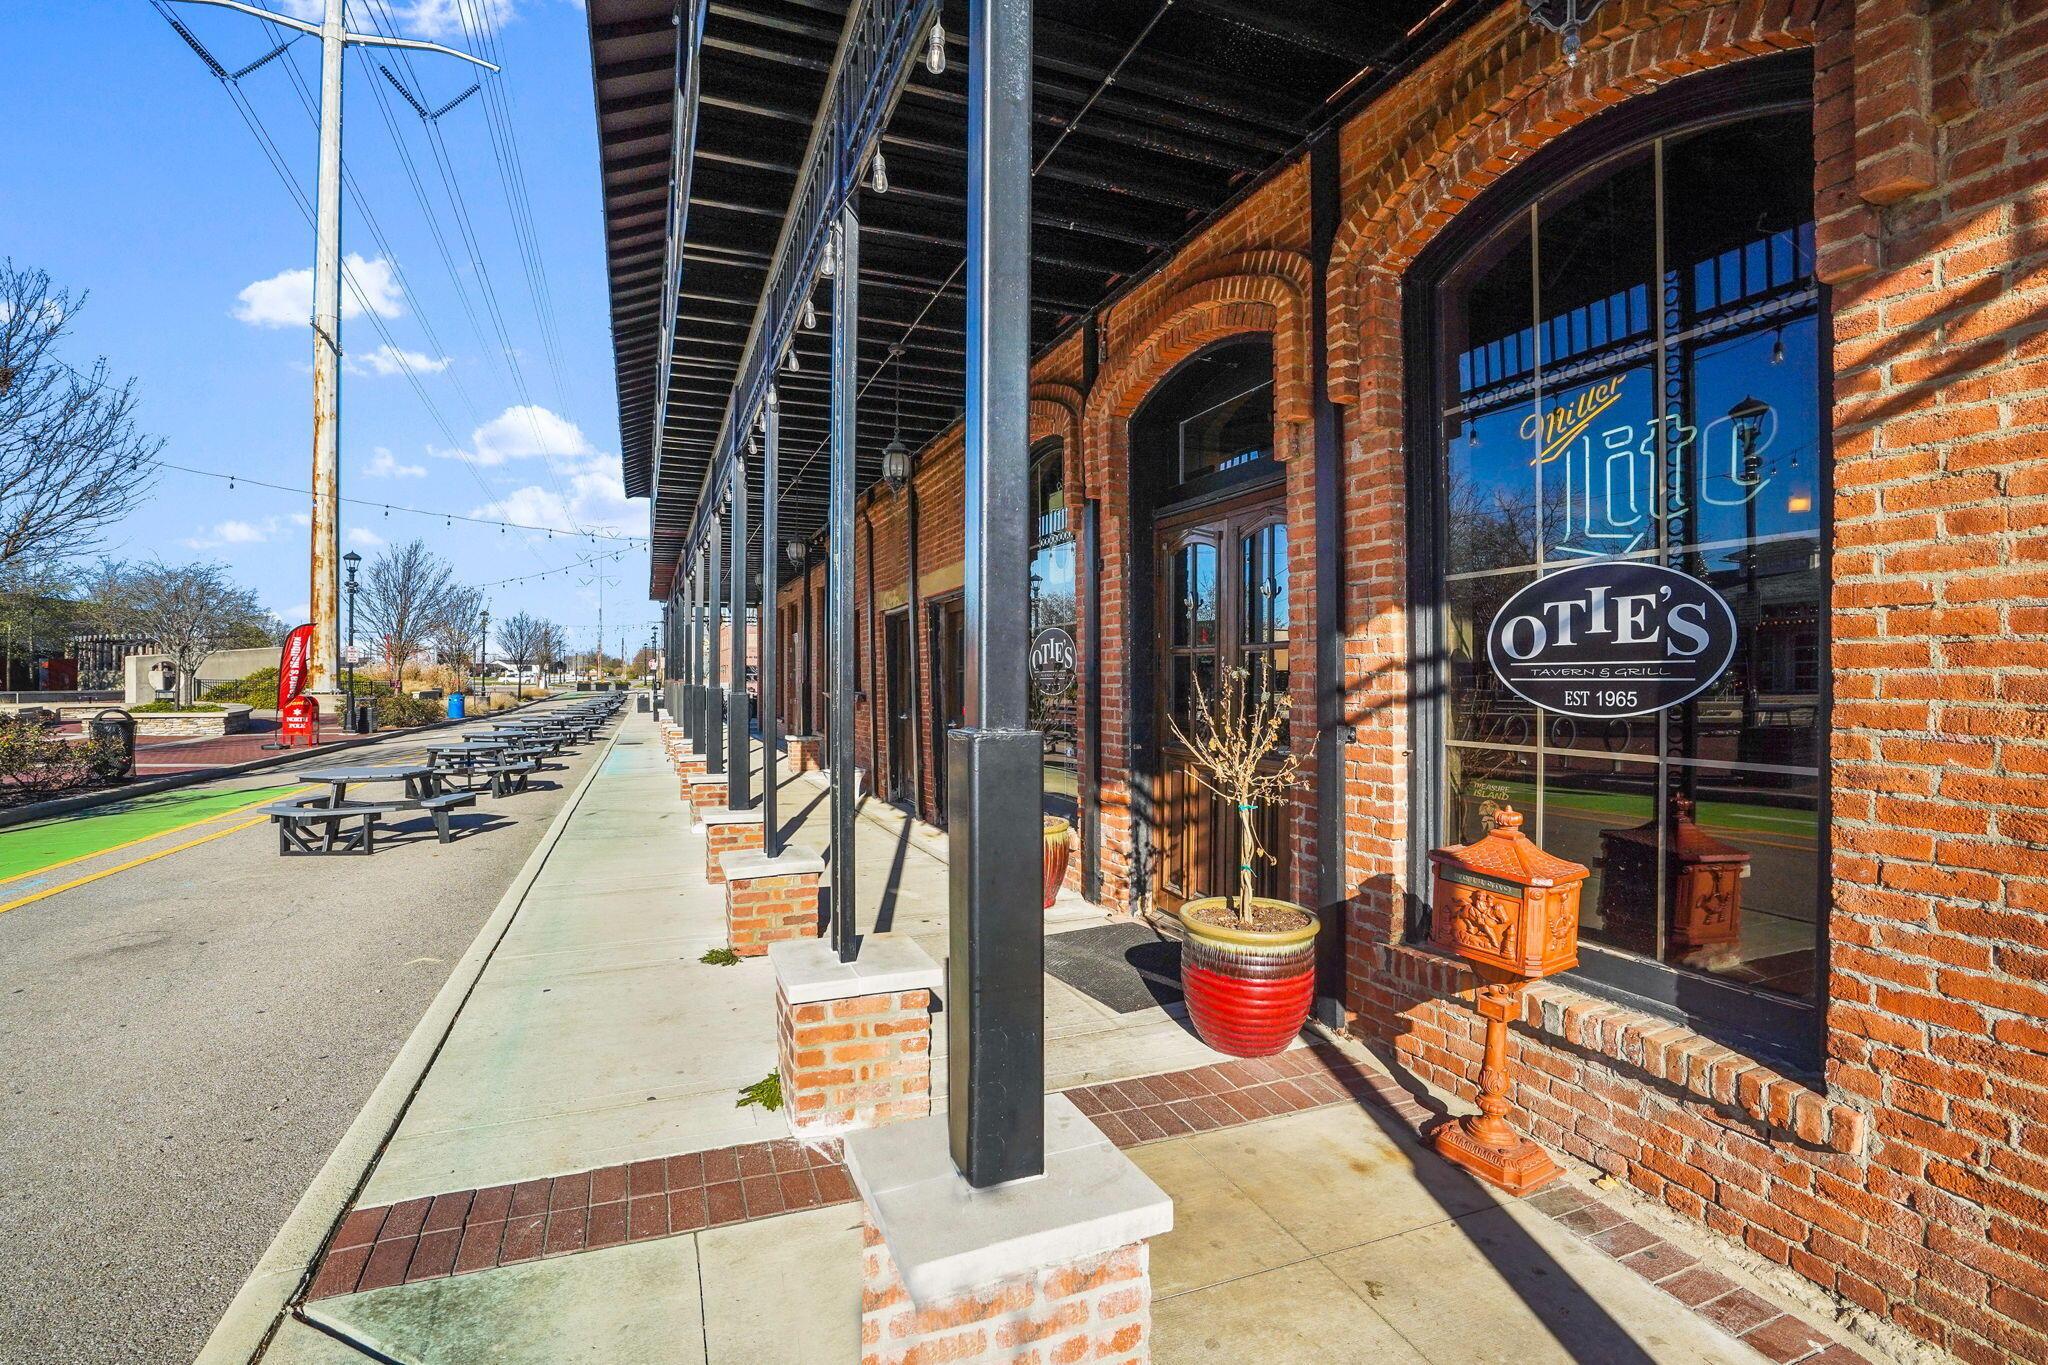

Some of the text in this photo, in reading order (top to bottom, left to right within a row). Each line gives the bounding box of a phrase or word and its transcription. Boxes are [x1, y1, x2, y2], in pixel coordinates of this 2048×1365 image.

[1519, 373, 1628, 444] Miller
[1501, 585, 1710, 660] OTIE'S
[290, 637, 302, 668] Mailbox
[1530, 667, 1672, 679] TAVERN & GRILL
[1564, 690, 1638, 707] EST 1965
[1473, 790, 1510, 801] ISLAND
[1474, 782, 1510, 792] TREASURE
